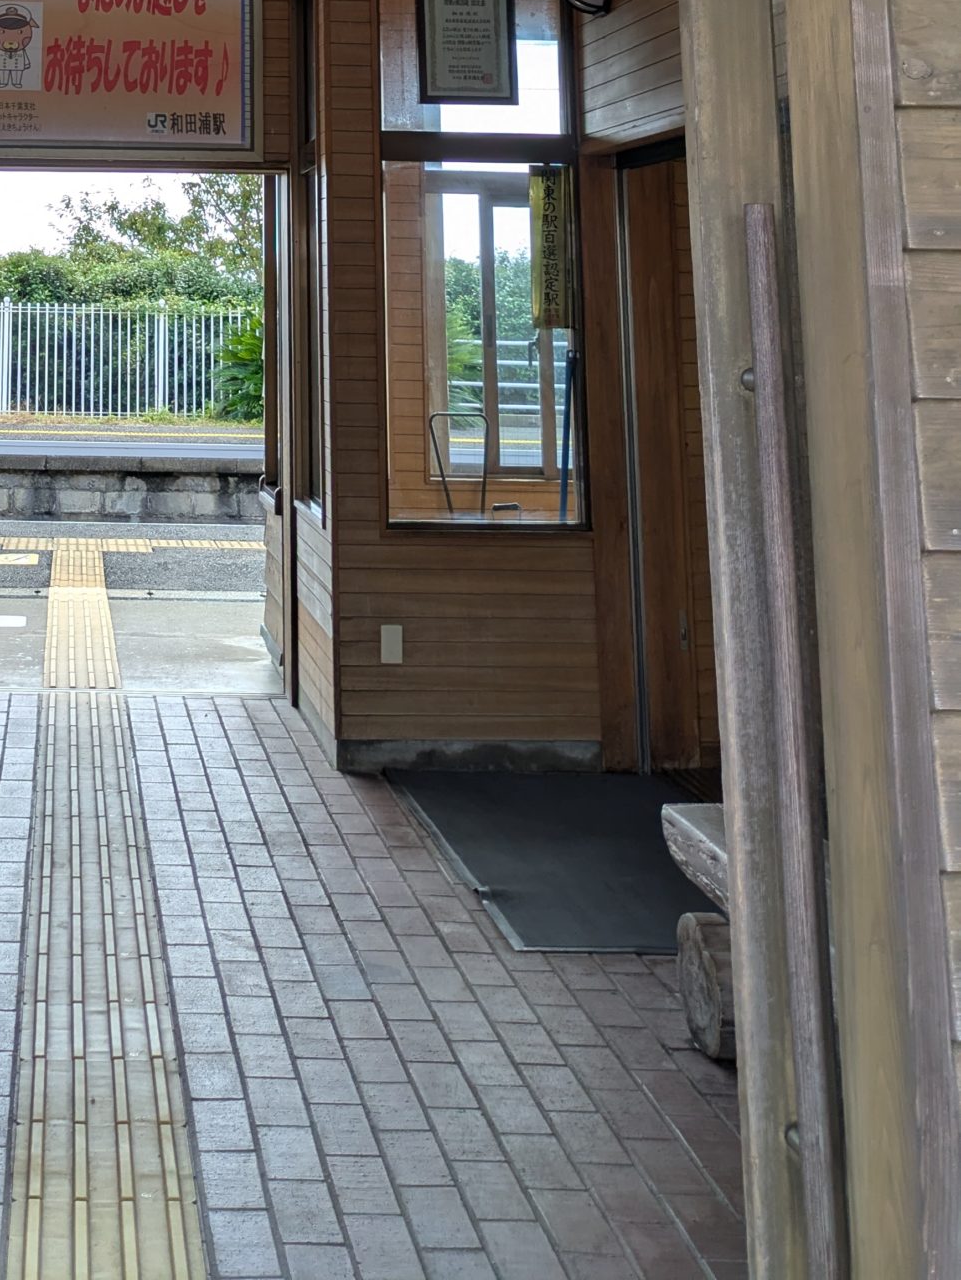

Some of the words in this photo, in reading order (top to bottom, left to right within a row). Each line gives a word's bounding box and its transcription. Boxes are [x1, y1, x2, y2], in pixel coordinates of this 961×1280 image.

[147, 113, 168, 128] JR
[170, 111, 227, 136] 和田浦駅
[541, 170, 560, 307] 関東の駅百選認定駅
